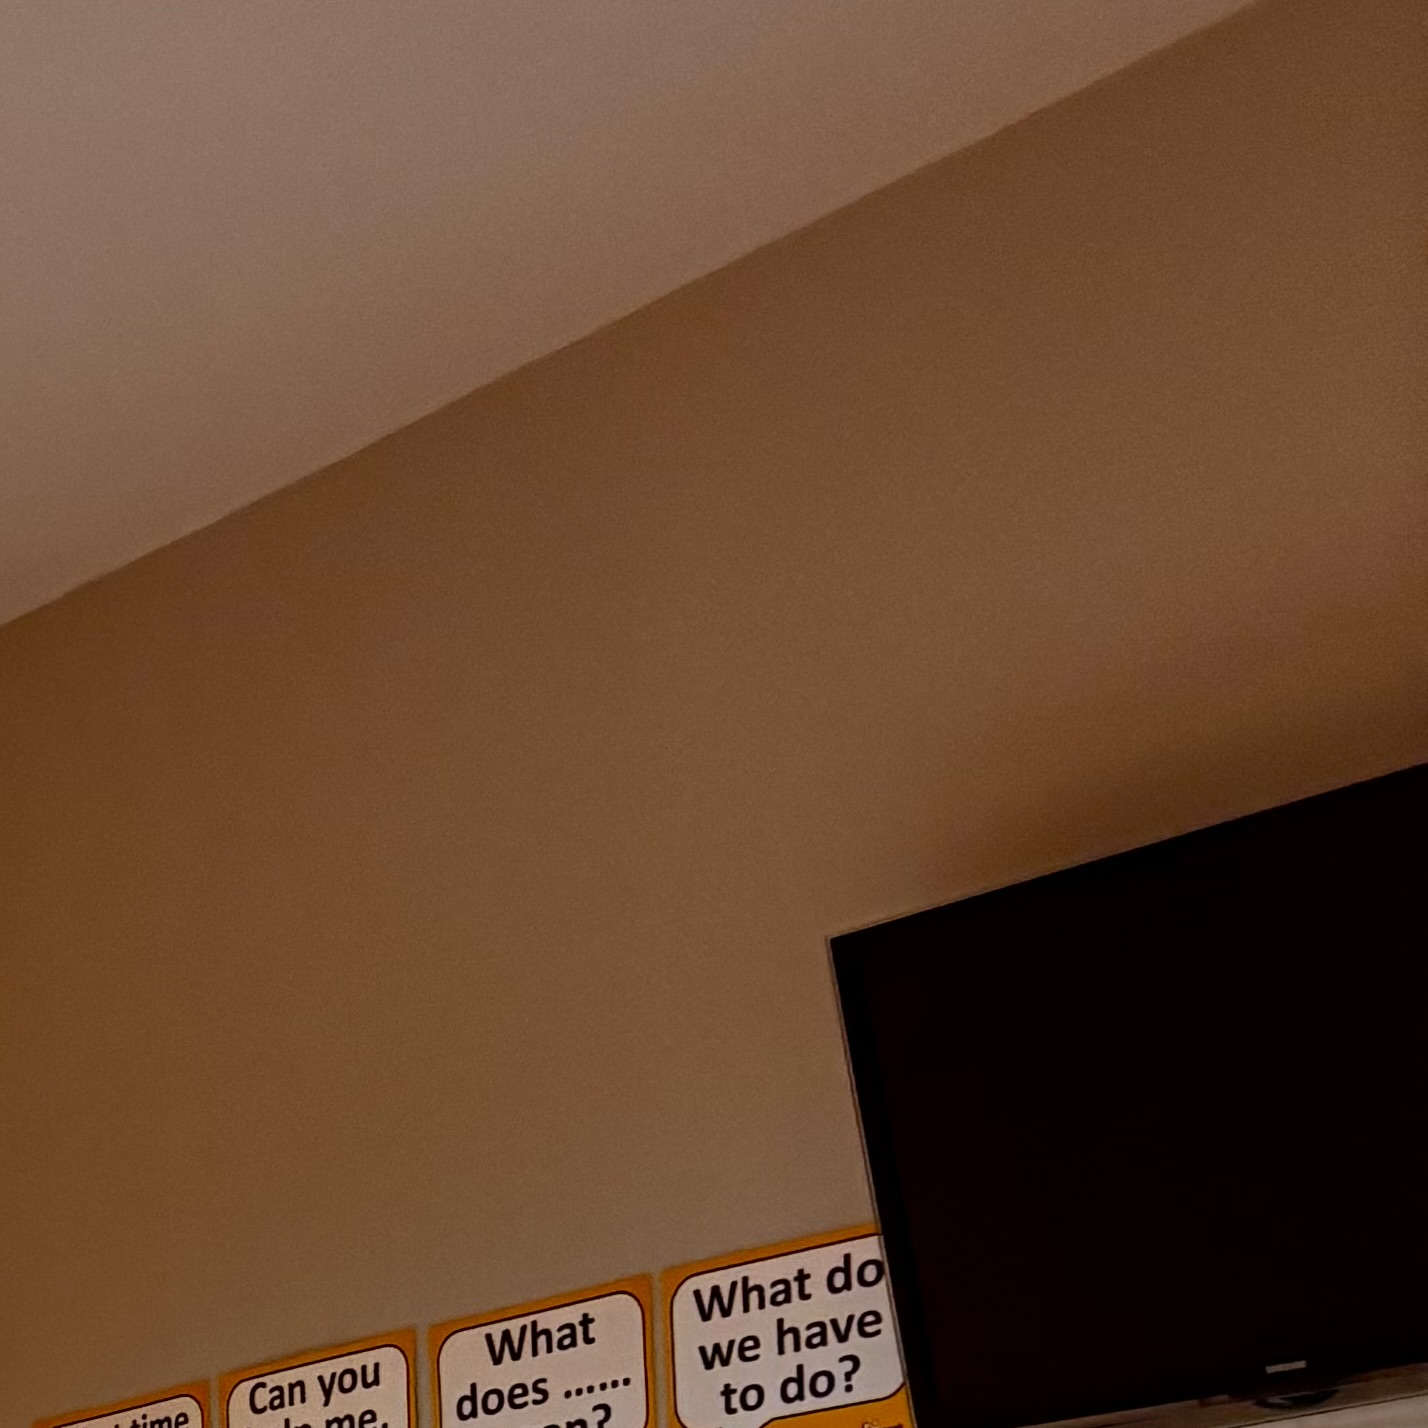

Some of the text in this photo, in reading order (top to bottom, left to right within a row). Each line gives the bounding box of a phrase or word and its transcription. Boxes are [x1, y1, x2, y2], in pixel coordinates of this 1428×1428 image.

[692, 1252, 885, 1323] What do
[484, 1312, 596, 1366] What
[697, 1309, 883, 1371] we have
[248, 1361, 381, 1415] Can you
[456, 1377, 550, 1422] does
[719, 1354, 861, 1416] to do?
